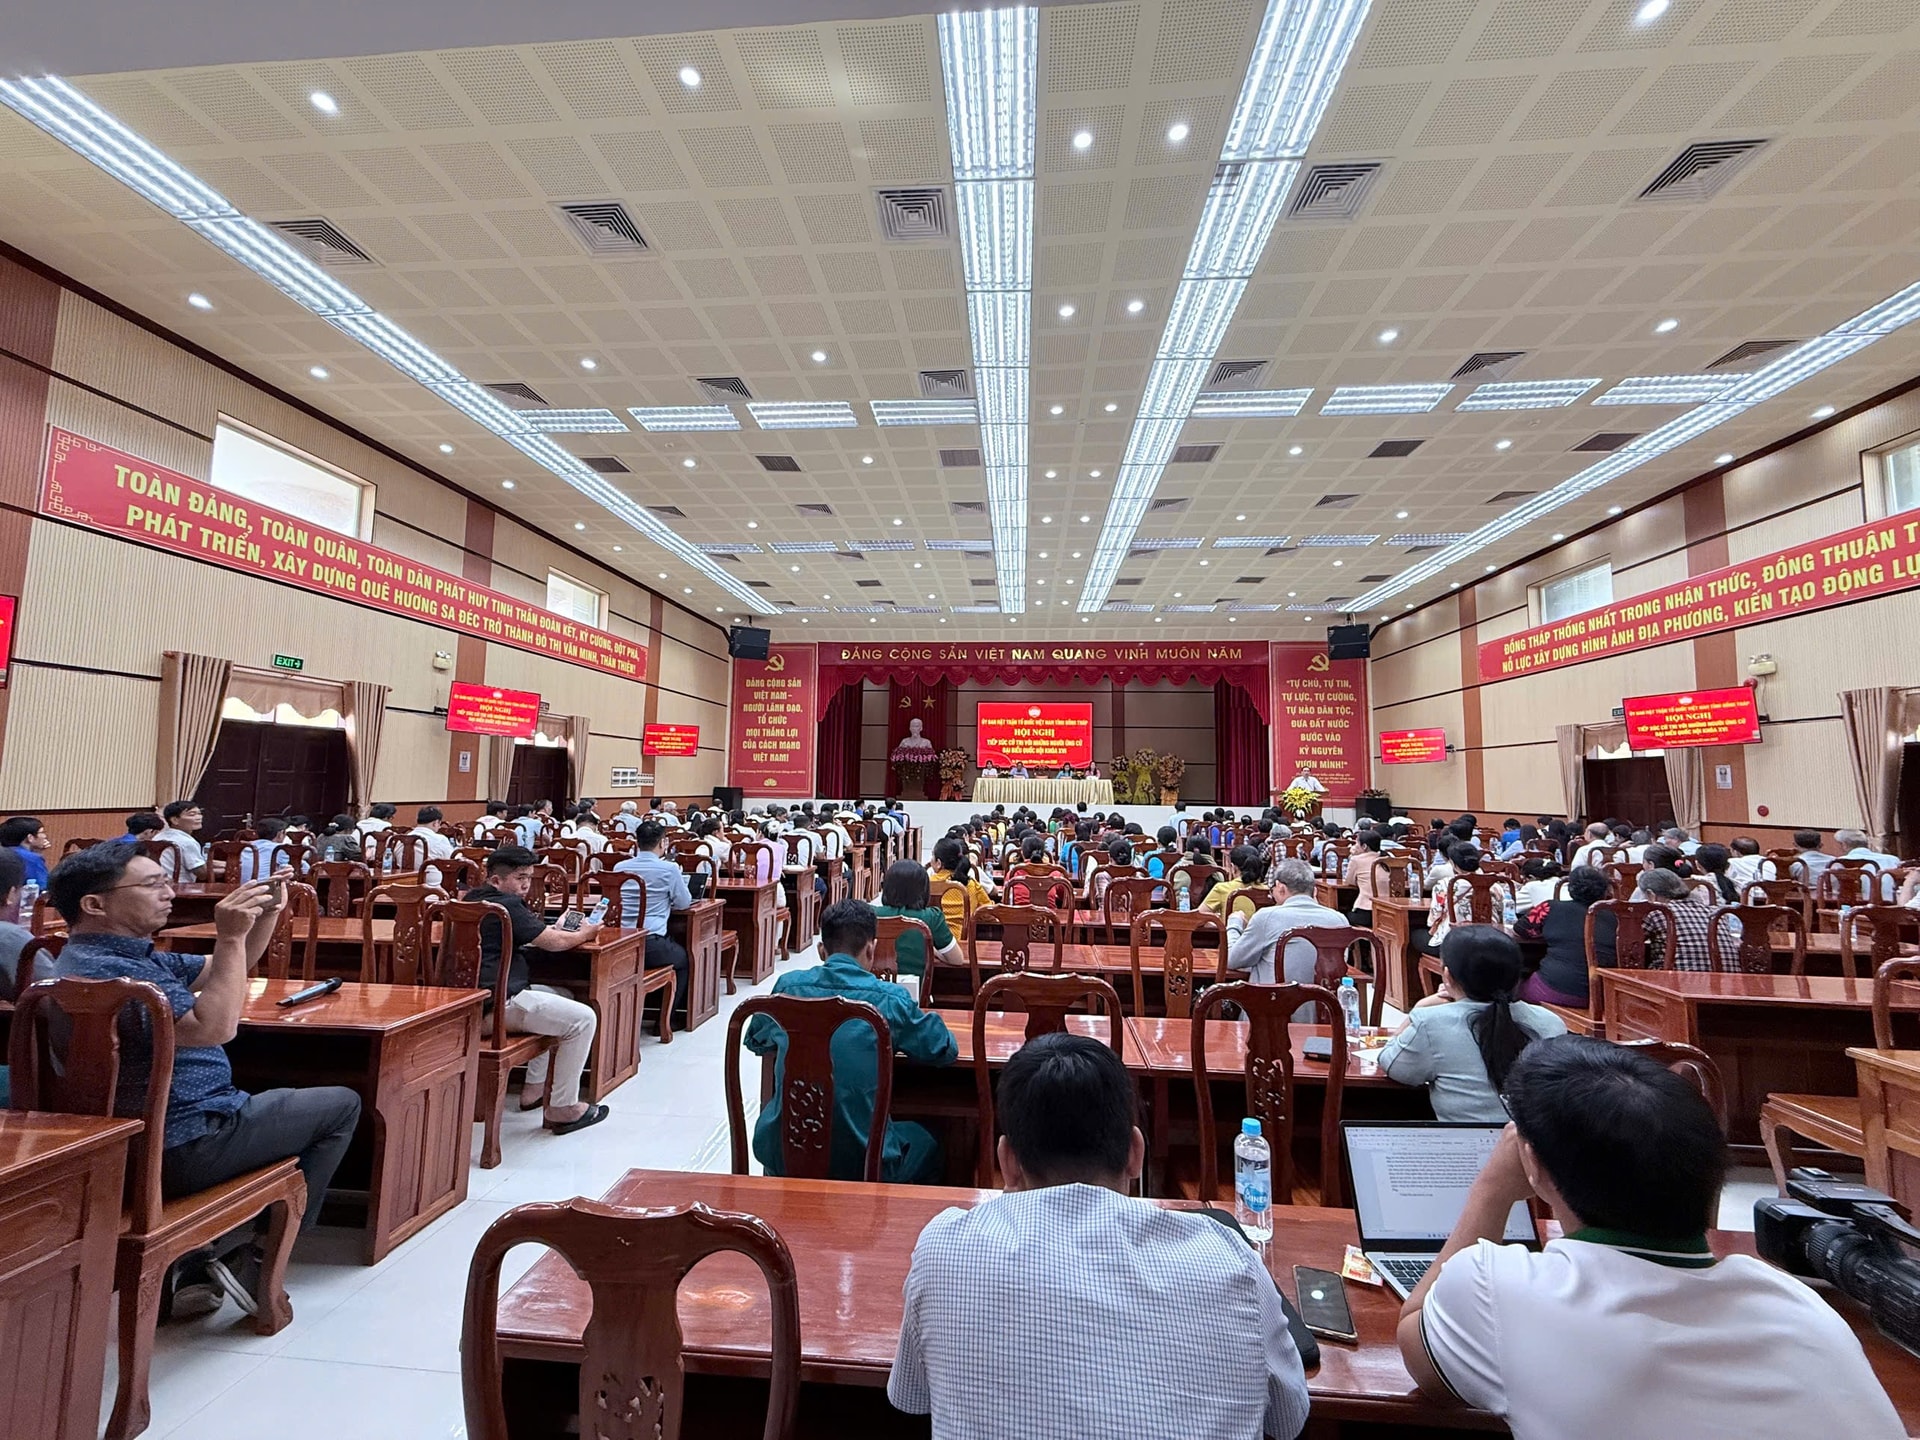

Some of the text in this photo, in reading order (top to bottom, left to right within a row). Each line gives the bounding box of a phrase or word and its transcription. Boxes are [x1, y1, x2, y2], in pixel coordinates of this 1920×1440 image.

[115, 464, 180, 506] TOÀN
[188, 493, 253, 533] ĐẢNG,
[261, 516, 308, 548] TOÀN
[314, 536, 362, 570] QUÂN,
[367, 554, 402, 580] TOÀN
[407, 569, 432, 590] DÂN
[436, 579, 466, 600] PHÁT
[468, 591, 489, 610] HUY
[491, 599, 513, 618] TINH
[516, 608, 537, 626] THẦN
[540, 616, 561, 634] ĐOÀN
[563, 622, 578, 641] KẾT,
[127, 504, 192, 542] PHÁT
[199, 527, 265, 568] TRIỂN,
[272, 550, 307, 576] XÂY
[312, 563, 356, 592] DỰNG
[361, 579, 390, 601] QUÊ
[394, 589, 437, 616] HƯƠNG
[441, 603, 455, 621] SA
[458, 607, 480, 628] ĐÉC
[483, 617, 502, 634] TRỞ
[504, 624, 533, 642] THÀNH
[535, 633, 547, 647] ĐÔ
[549, 638, 562, 654] THỊ
[564, 642, 578, 657] VĂN
[579, 648, 598, 664] MINH,
[1504, 639, 1526, 655] ĐỒNG
[1528, 632, 1550, 650] THÁP
[1553, 620, 1585, 642] THỐNG
[1588, 608, 1617, 632] NHẤT
[1620, 599, 1660, 622] TRONG
[1665, 585, 1704, 610] NHẬN
[1708, 571, 1757, 598] THỨC,
[1762, 554, 1814, 583] ĐỒNG
[1821, 529, 1896, 566] THUẬN
[1516, 655, 1531, 671] LỰC
[1533, 651, 1550, 666] XÂY
[1552, 644, 1578, 663] DỰNG
[1581, 636, 1608, 653] HÌNH
[1611, 629, 1634, 647] ẢNH
[1638, 622, 1660, 641] ĐỊA
[1664, 605, 1729, 634] PHƯƠNG,
[1734, 588, 1773, 617] KIẾN
[1778, 582, 1815, 608] TẠO
[1822, 564, 1884, 595] ĐỘNG
[842, 646, 1242, 661] ĐẢNG CỘNG SẢN VIỆT NAM QUANG VINH MUÔN NĂM
[276, 657, 295, 667] EXIT
[1324, 679, 1334, 688] TỰ
[1282, 692, 1292, 702] TỰ
[1315, 692, 1324, 702] TỰ
[1286, 706, 1296, 715] TỰ
[1317, 706, 1333, 714] DÂN
[1665, 712, 1711, 722] HỘI NGHỊ
[1014, 728, 1054, 738] HỘI NGHỊ
[1325, 732, 1341, 741] VÀO
[1312, 746, 1343, 755] NGUYÊN
